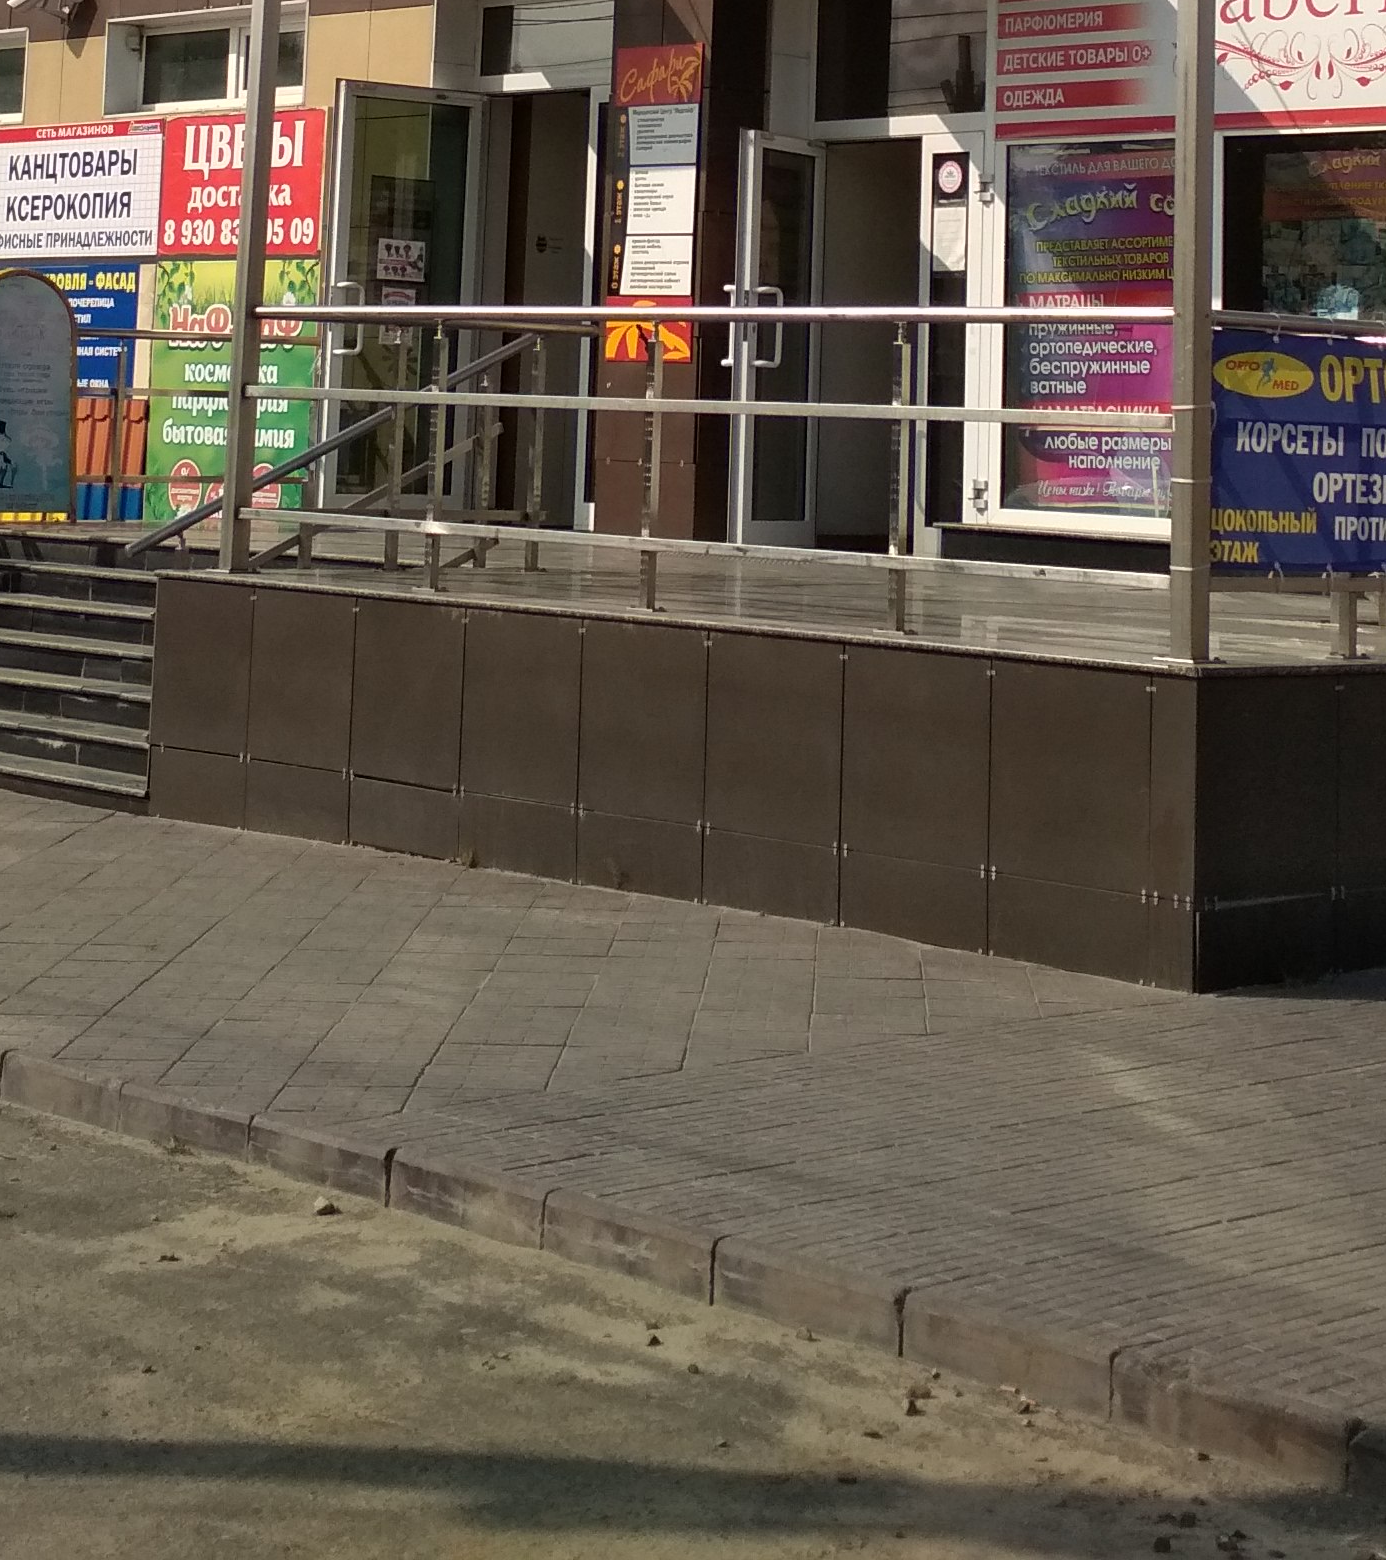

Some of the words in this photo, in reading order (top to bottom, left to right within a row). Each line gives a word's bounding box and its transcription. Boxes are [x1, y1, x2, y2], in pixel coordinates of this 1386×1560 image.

[1005, 11, 1103, 33] ПАРФЮМЕРИЯ
[1003, 51, 1065, 72] ДЕТСКИЕ
[1069, 47, 1128, 65] ТОВАРЫ
[1003, 88, 1065, 107] ОДЕЖДА
[37, 128, 57, 139] СЕТЬ
[58, 125, 114, 138] МАГАЗИНОВ
[183, 119, 306, 181] ЦВЕЫ
[9, 149, 137, 184] КАНЦТОВАРЫ
[1088, 161, 1112, 175] ДЛЯ
[1114, 158, 1159, 171] ВАШЕГО
[6, 191, 132, 222] КСЕРОКОПИЯ
[187, 183, 292, 214] достка
[46, 230, 152, 250] ПРИНАДЛЕЖНОСТИ
[164, 220, 175, 245] 8
[181, 219, 215, 245] 930
[290, 217, 314, 245] 09
[1036, 240, 1109, 252] ПРЕДСТАВЛЯЕТ
[1053, 254, 1122, 267] ТЕКСТИЛЬНЫХ
[1125, 252, 1169, 265] ТОВАРОВ
[96, 271, 136, 293] ФАСАД
[1020, 273, 1035, 283] ПО
[1038, 270, 1119, 283] МАКСИМАЛЬНО
[1123, 269, 1164, 280] НИЗКИМ
[1029, 340, 1157, 357] ортопедические,
[1029, 358, 1151, 378] беспружинные
[1225, 360, 1260, 371] ORTO
[1273, 379, 1299, 391] MED
[1030, 380, 1087, 394] ватные
[1044, 433, 1098, 450] любые
[1101, 435, 1172, 454] размеры
[1236, 421, 1344, 456] КОРСЕТЫ
[1068, 455, 1161, 470] наполнение
[1211, 506, 1317, 535] ЦОКОЛЬНЫЙ
[1211, 540, 1259, 563] ЭТАЖ
